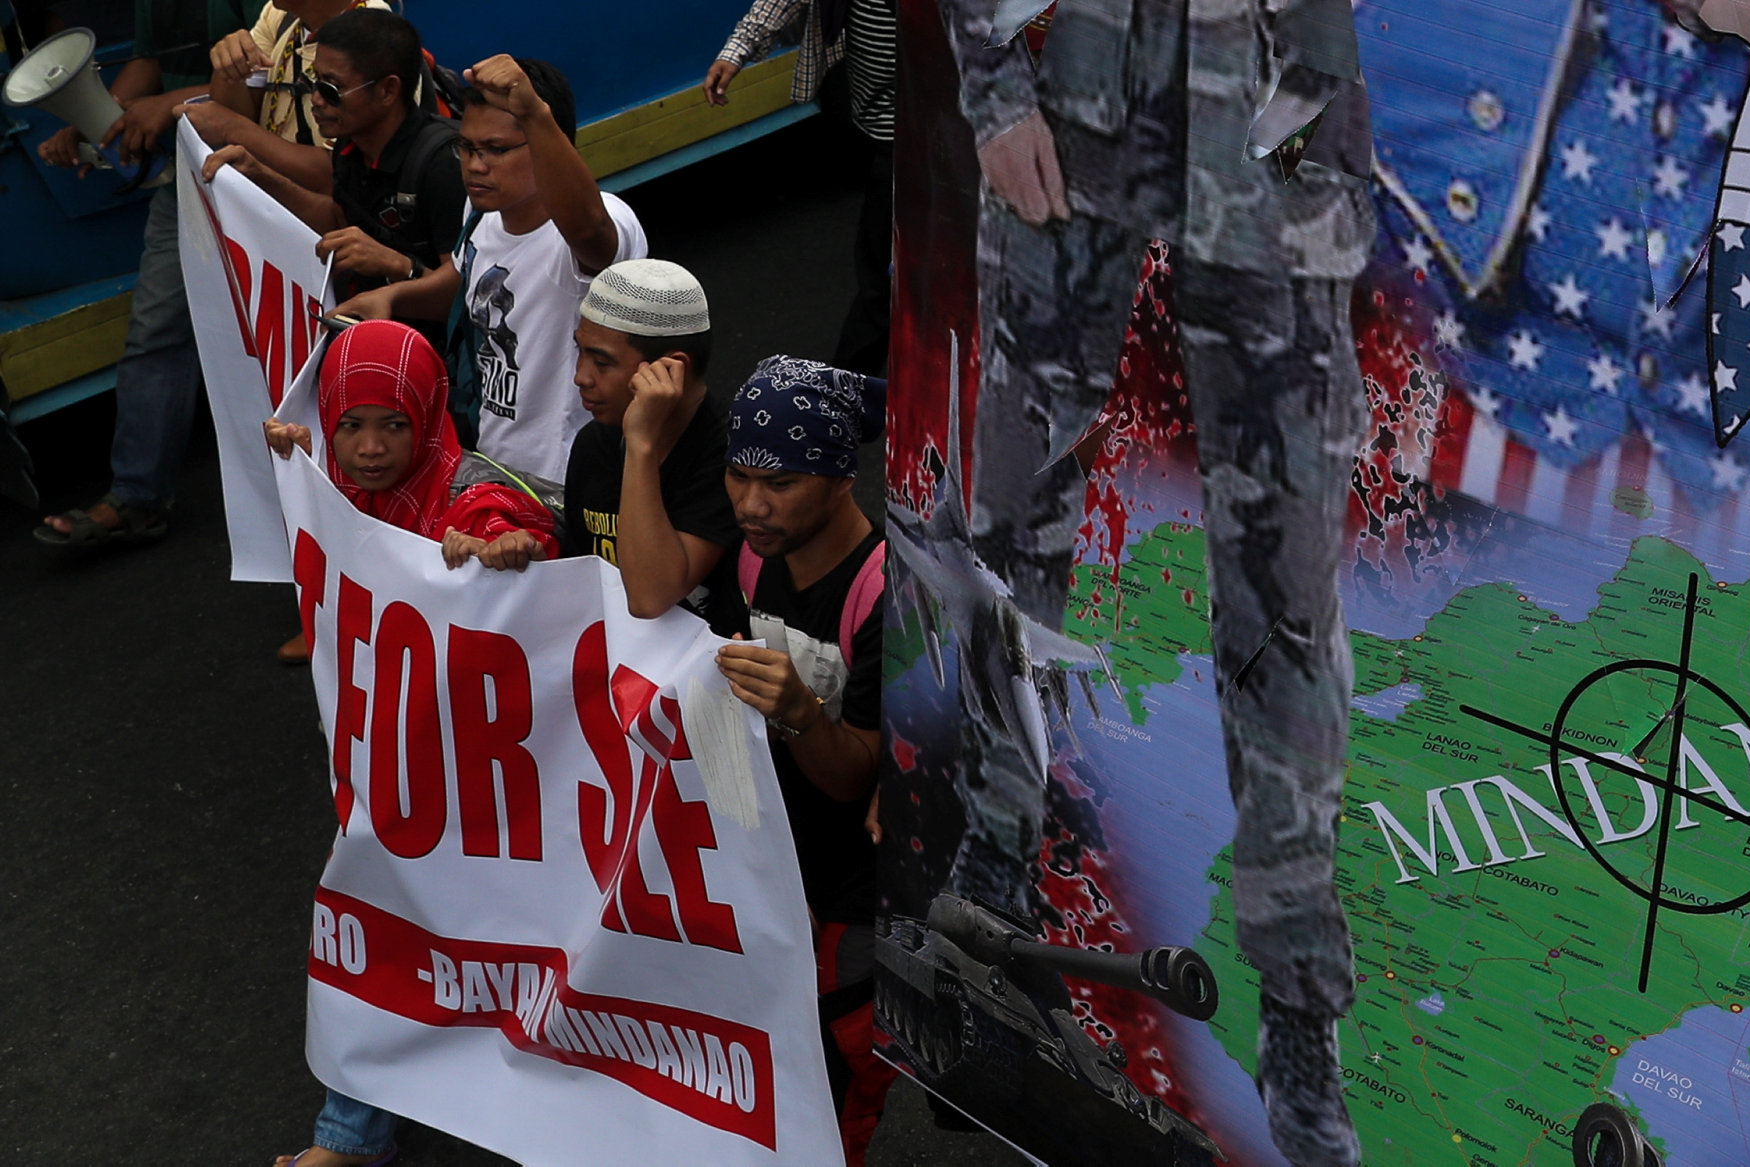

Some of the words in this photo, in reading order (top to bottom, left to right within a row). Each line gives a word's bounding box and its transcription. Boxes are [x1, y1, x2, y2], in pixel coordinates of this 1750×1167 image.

[332, 570, 543, 861] FOR
[1426, 731, 1472, 752] LANAO
[1542, 722, 1619, 749] BKIDNON
[1422, 741, 1448, 756] DEL
[1449, 748, 1480, 764] SUR
[1482, 866, 1560, 897] COTABATO
[1559, 947, 1605, 970] Kidapawan
[1715, 980, 1746, 998] Davao
[544, 989, 756, 1114] MINDANAO
[1424, 1039, 1466, 1063] Koronadal
[1581, 1037, 1607, 1054] Digos
[1637, 1058, 1694, 1090] DAVAO
[1631, 1072, 1663, 1095] DEL
[1666, 1086, 1704, 1111] SUR
